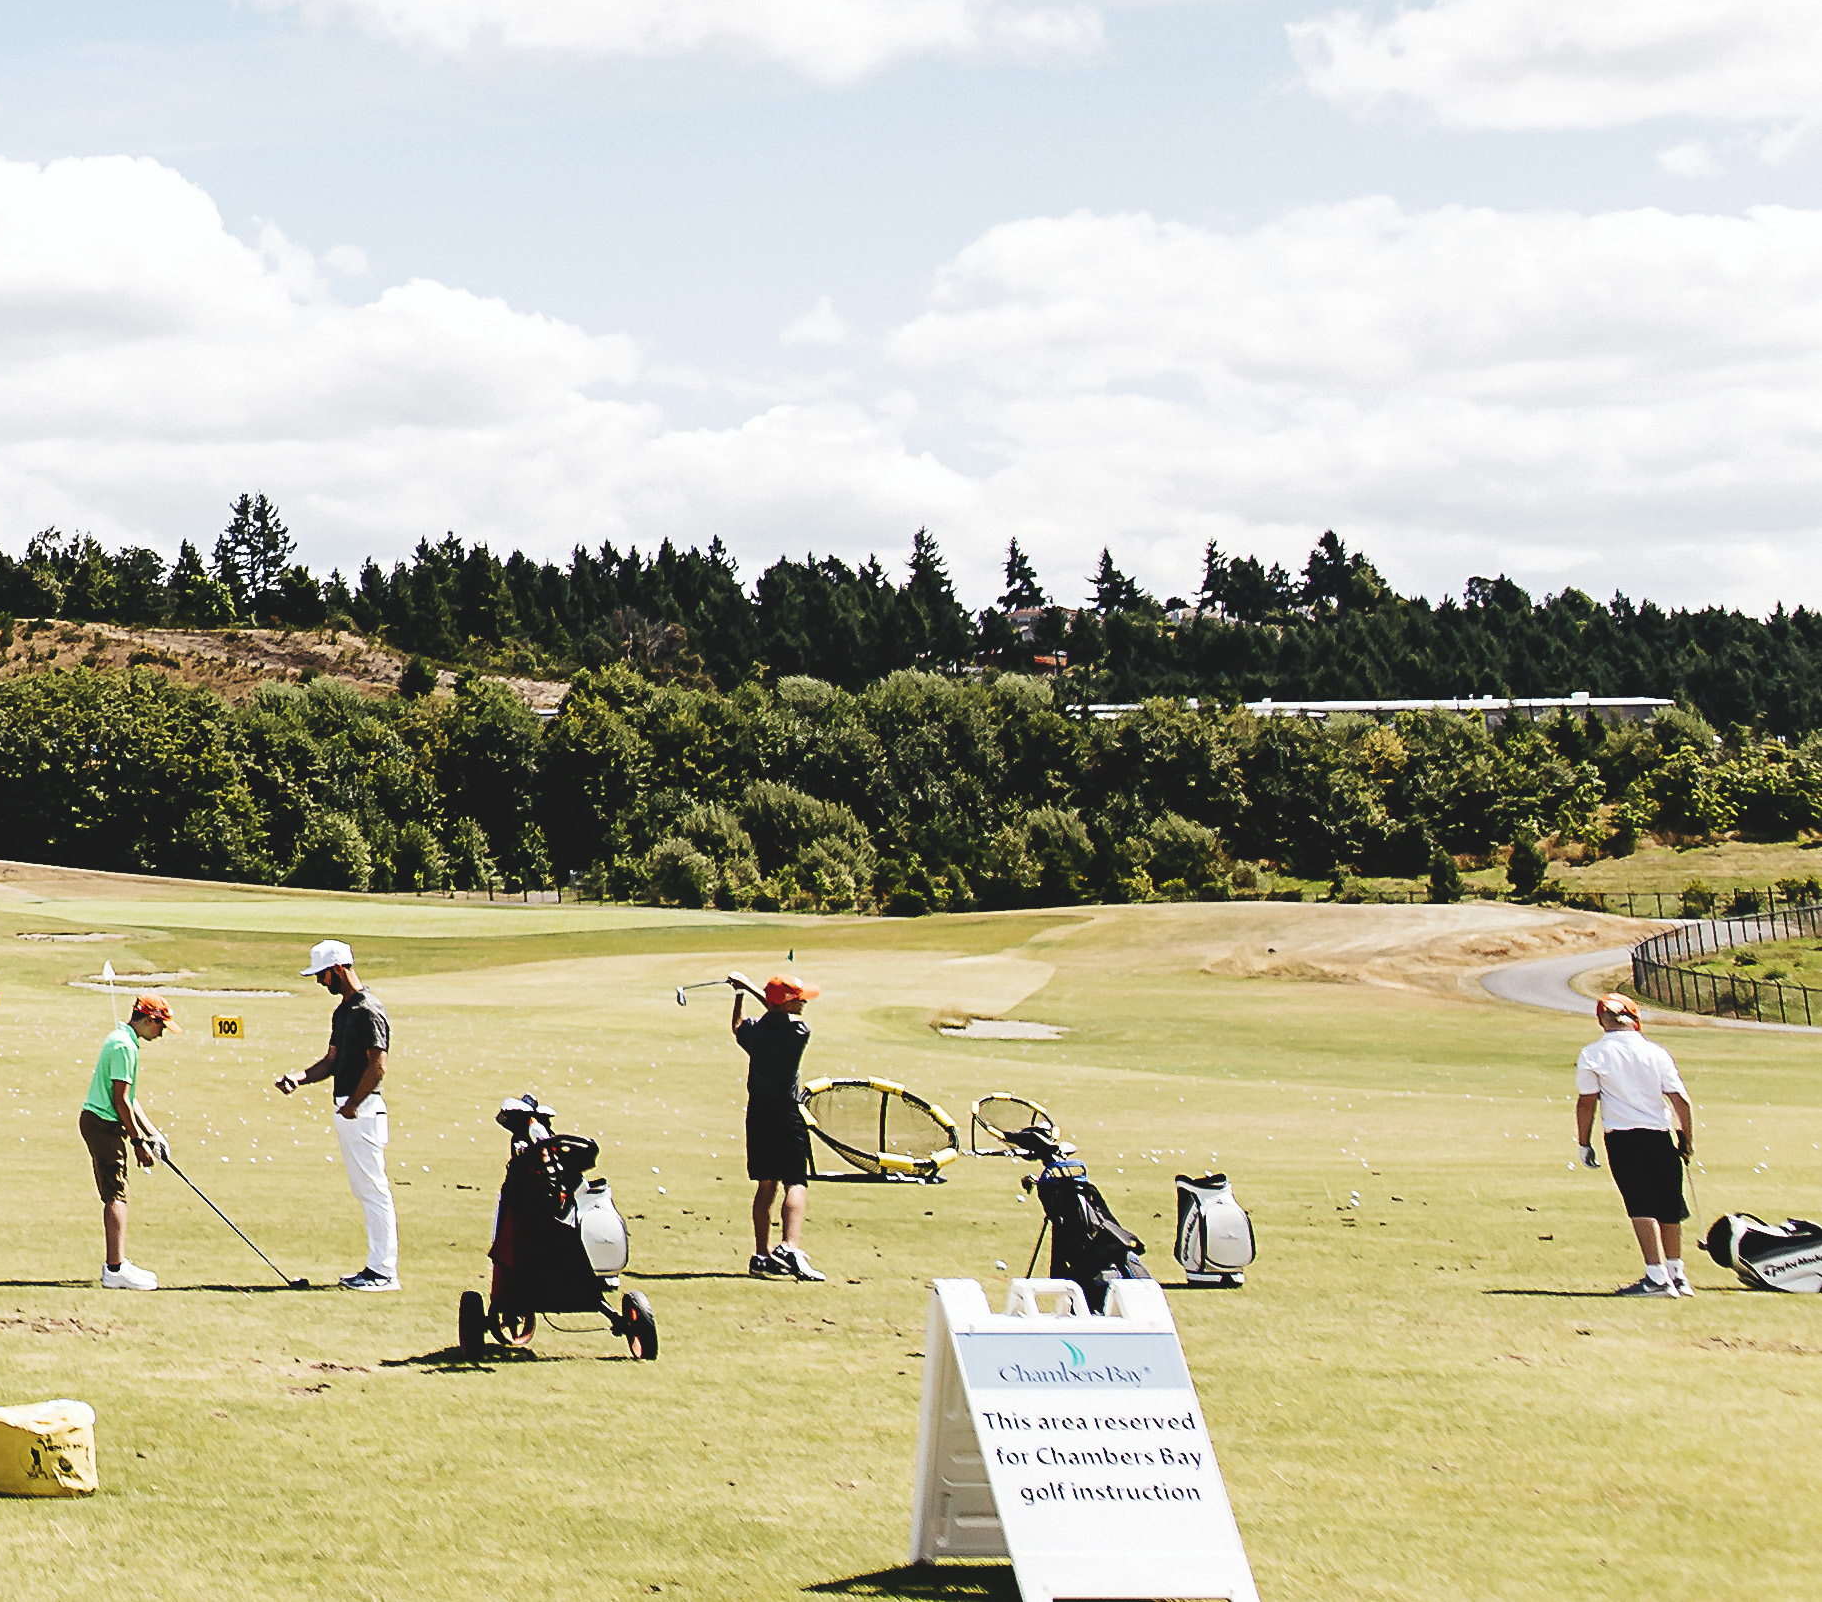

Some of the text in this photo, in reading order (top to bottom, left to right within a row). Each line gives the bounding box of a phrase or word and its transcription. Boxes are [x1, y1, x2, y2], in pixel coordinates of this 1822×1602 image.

[218, 1020, 237, 1035] 100
[998, 1360, 1104, 1384] Chambers
[982, 1411, 1197, 1431] This area reserved
[996, 1446, 1202, 1470] for Chambers Bay
[1020, 1482, 1203, 1506] golf instruction
